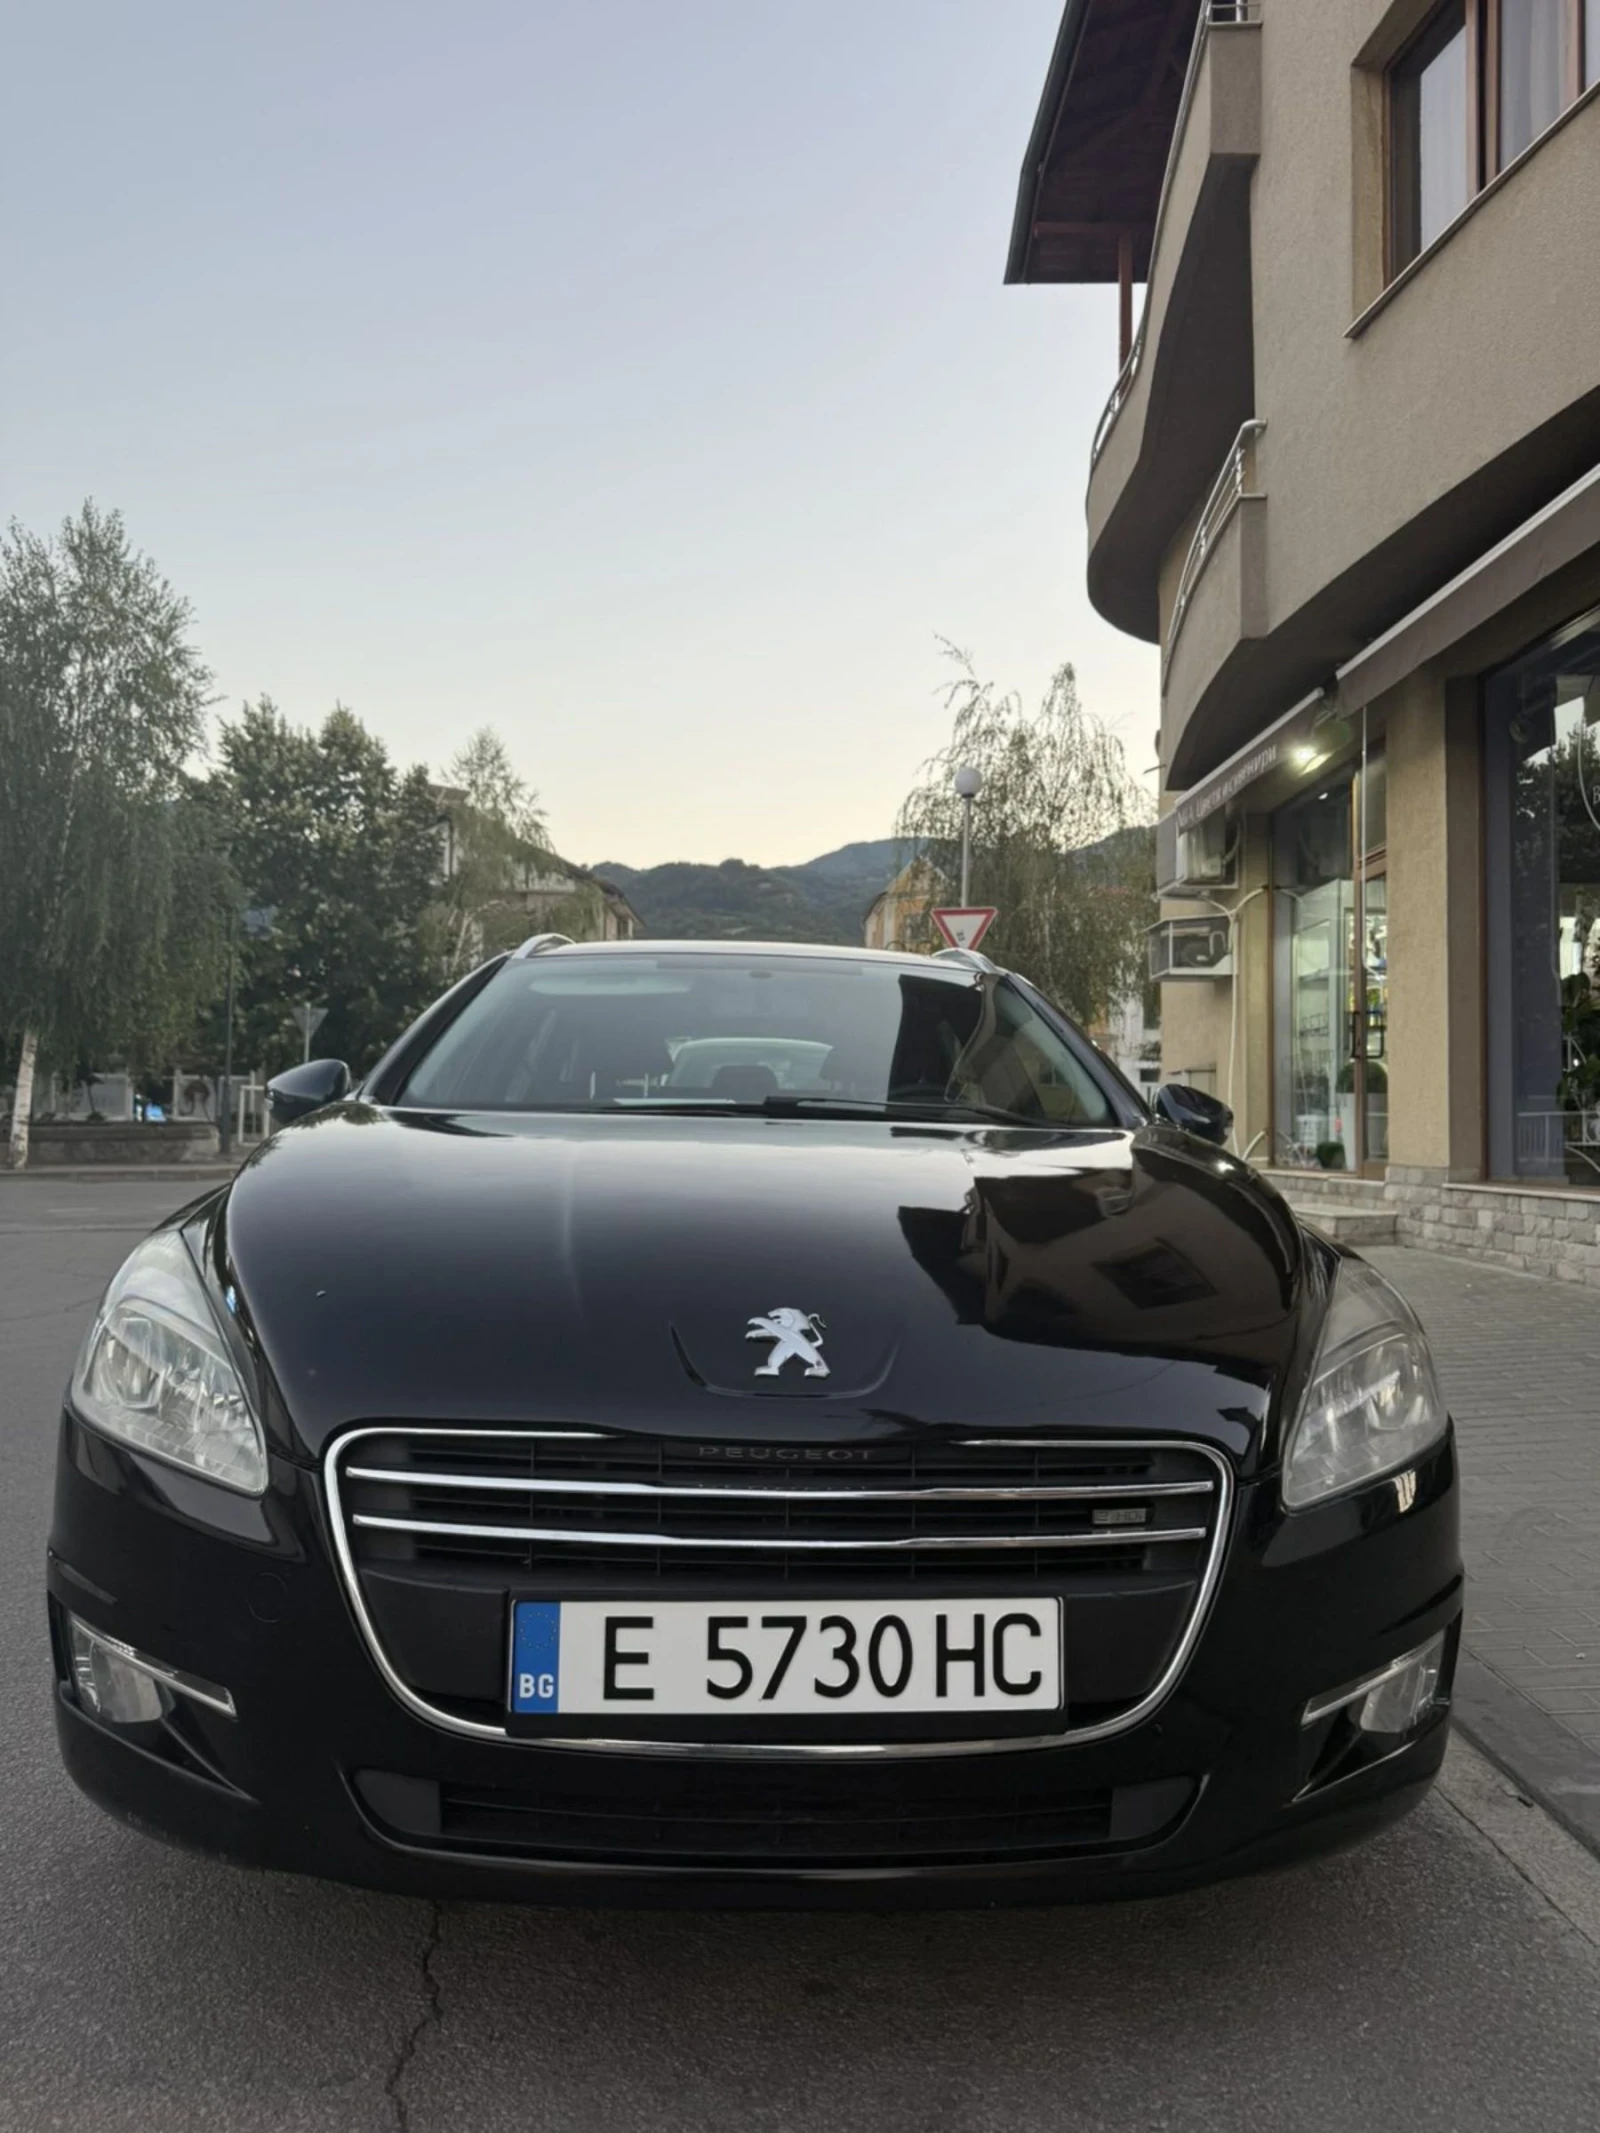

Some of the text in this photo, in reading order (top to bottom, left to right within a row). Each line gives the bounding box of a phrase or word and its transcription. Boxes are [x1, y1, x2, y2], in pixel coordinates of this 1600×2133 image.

[698, 1446, 876, 1461] PEUGEOT
[603, 1612, 1042, 1700] E 5730 HC
[519, 1673, 554, 1698] BG
